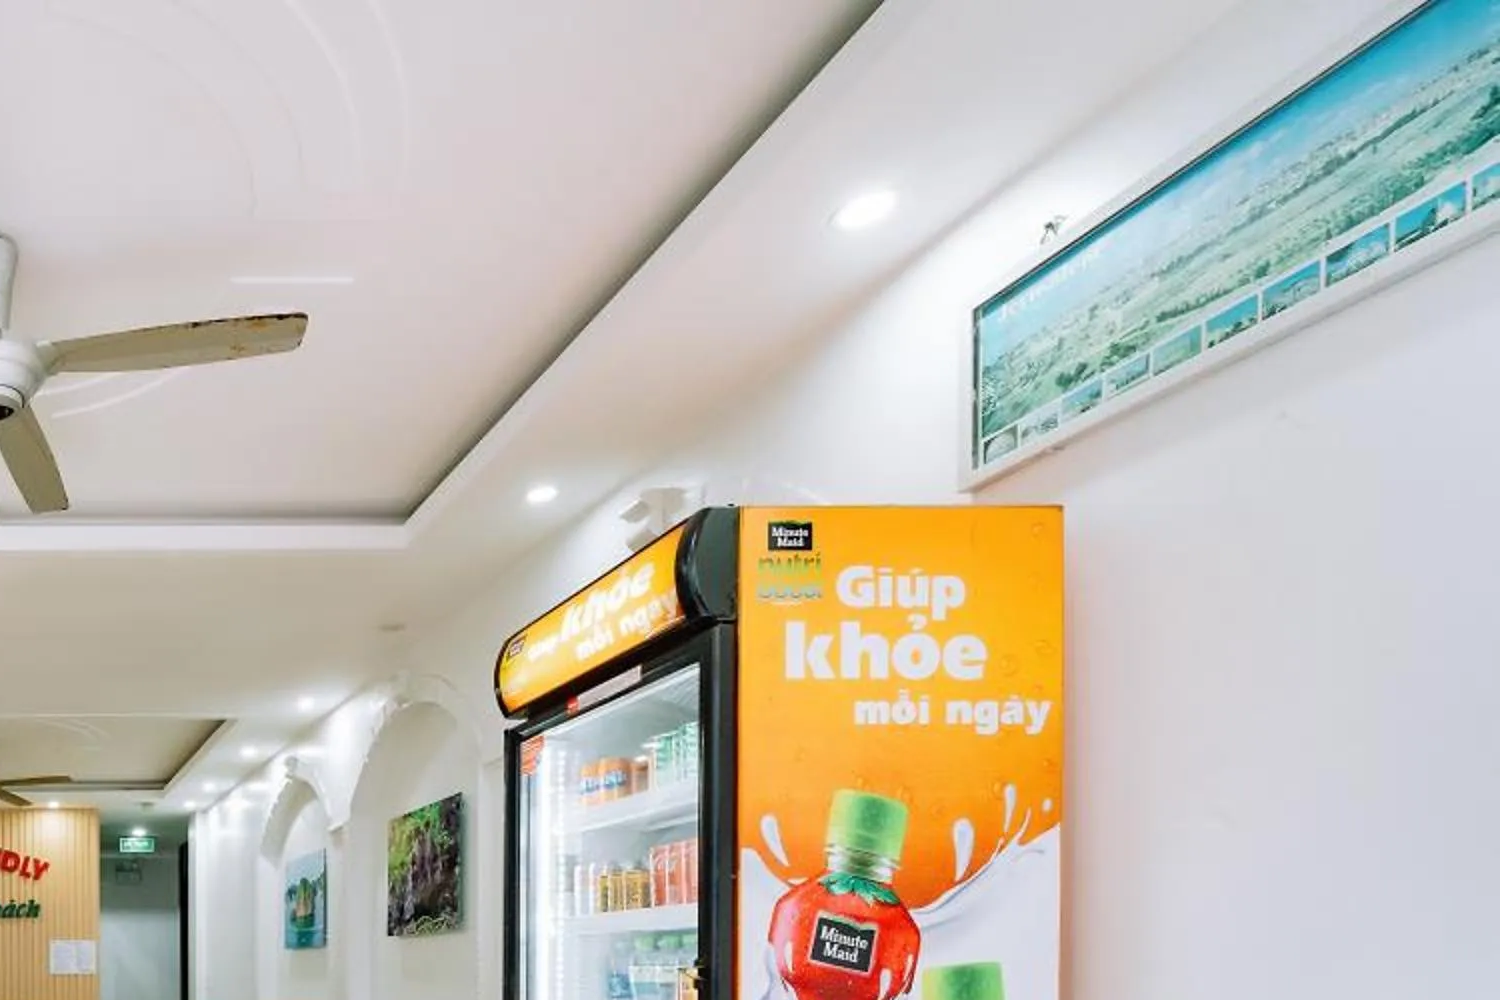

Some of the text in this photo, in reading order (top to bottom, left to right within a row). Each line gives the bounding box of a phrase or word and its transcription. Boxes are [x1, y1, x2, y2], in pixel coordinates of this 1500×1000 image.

[771, 526, 809, 538] Minute
[777, 536, 805, 548] Maid
[836, 565, 966, 621] Giúp
[784, 614, 988, 681] khỏe
[946, 694, 1051, 735] ngày
[819, 924, 869, 951] Minute
[822, 941, 859, 964] Maid
